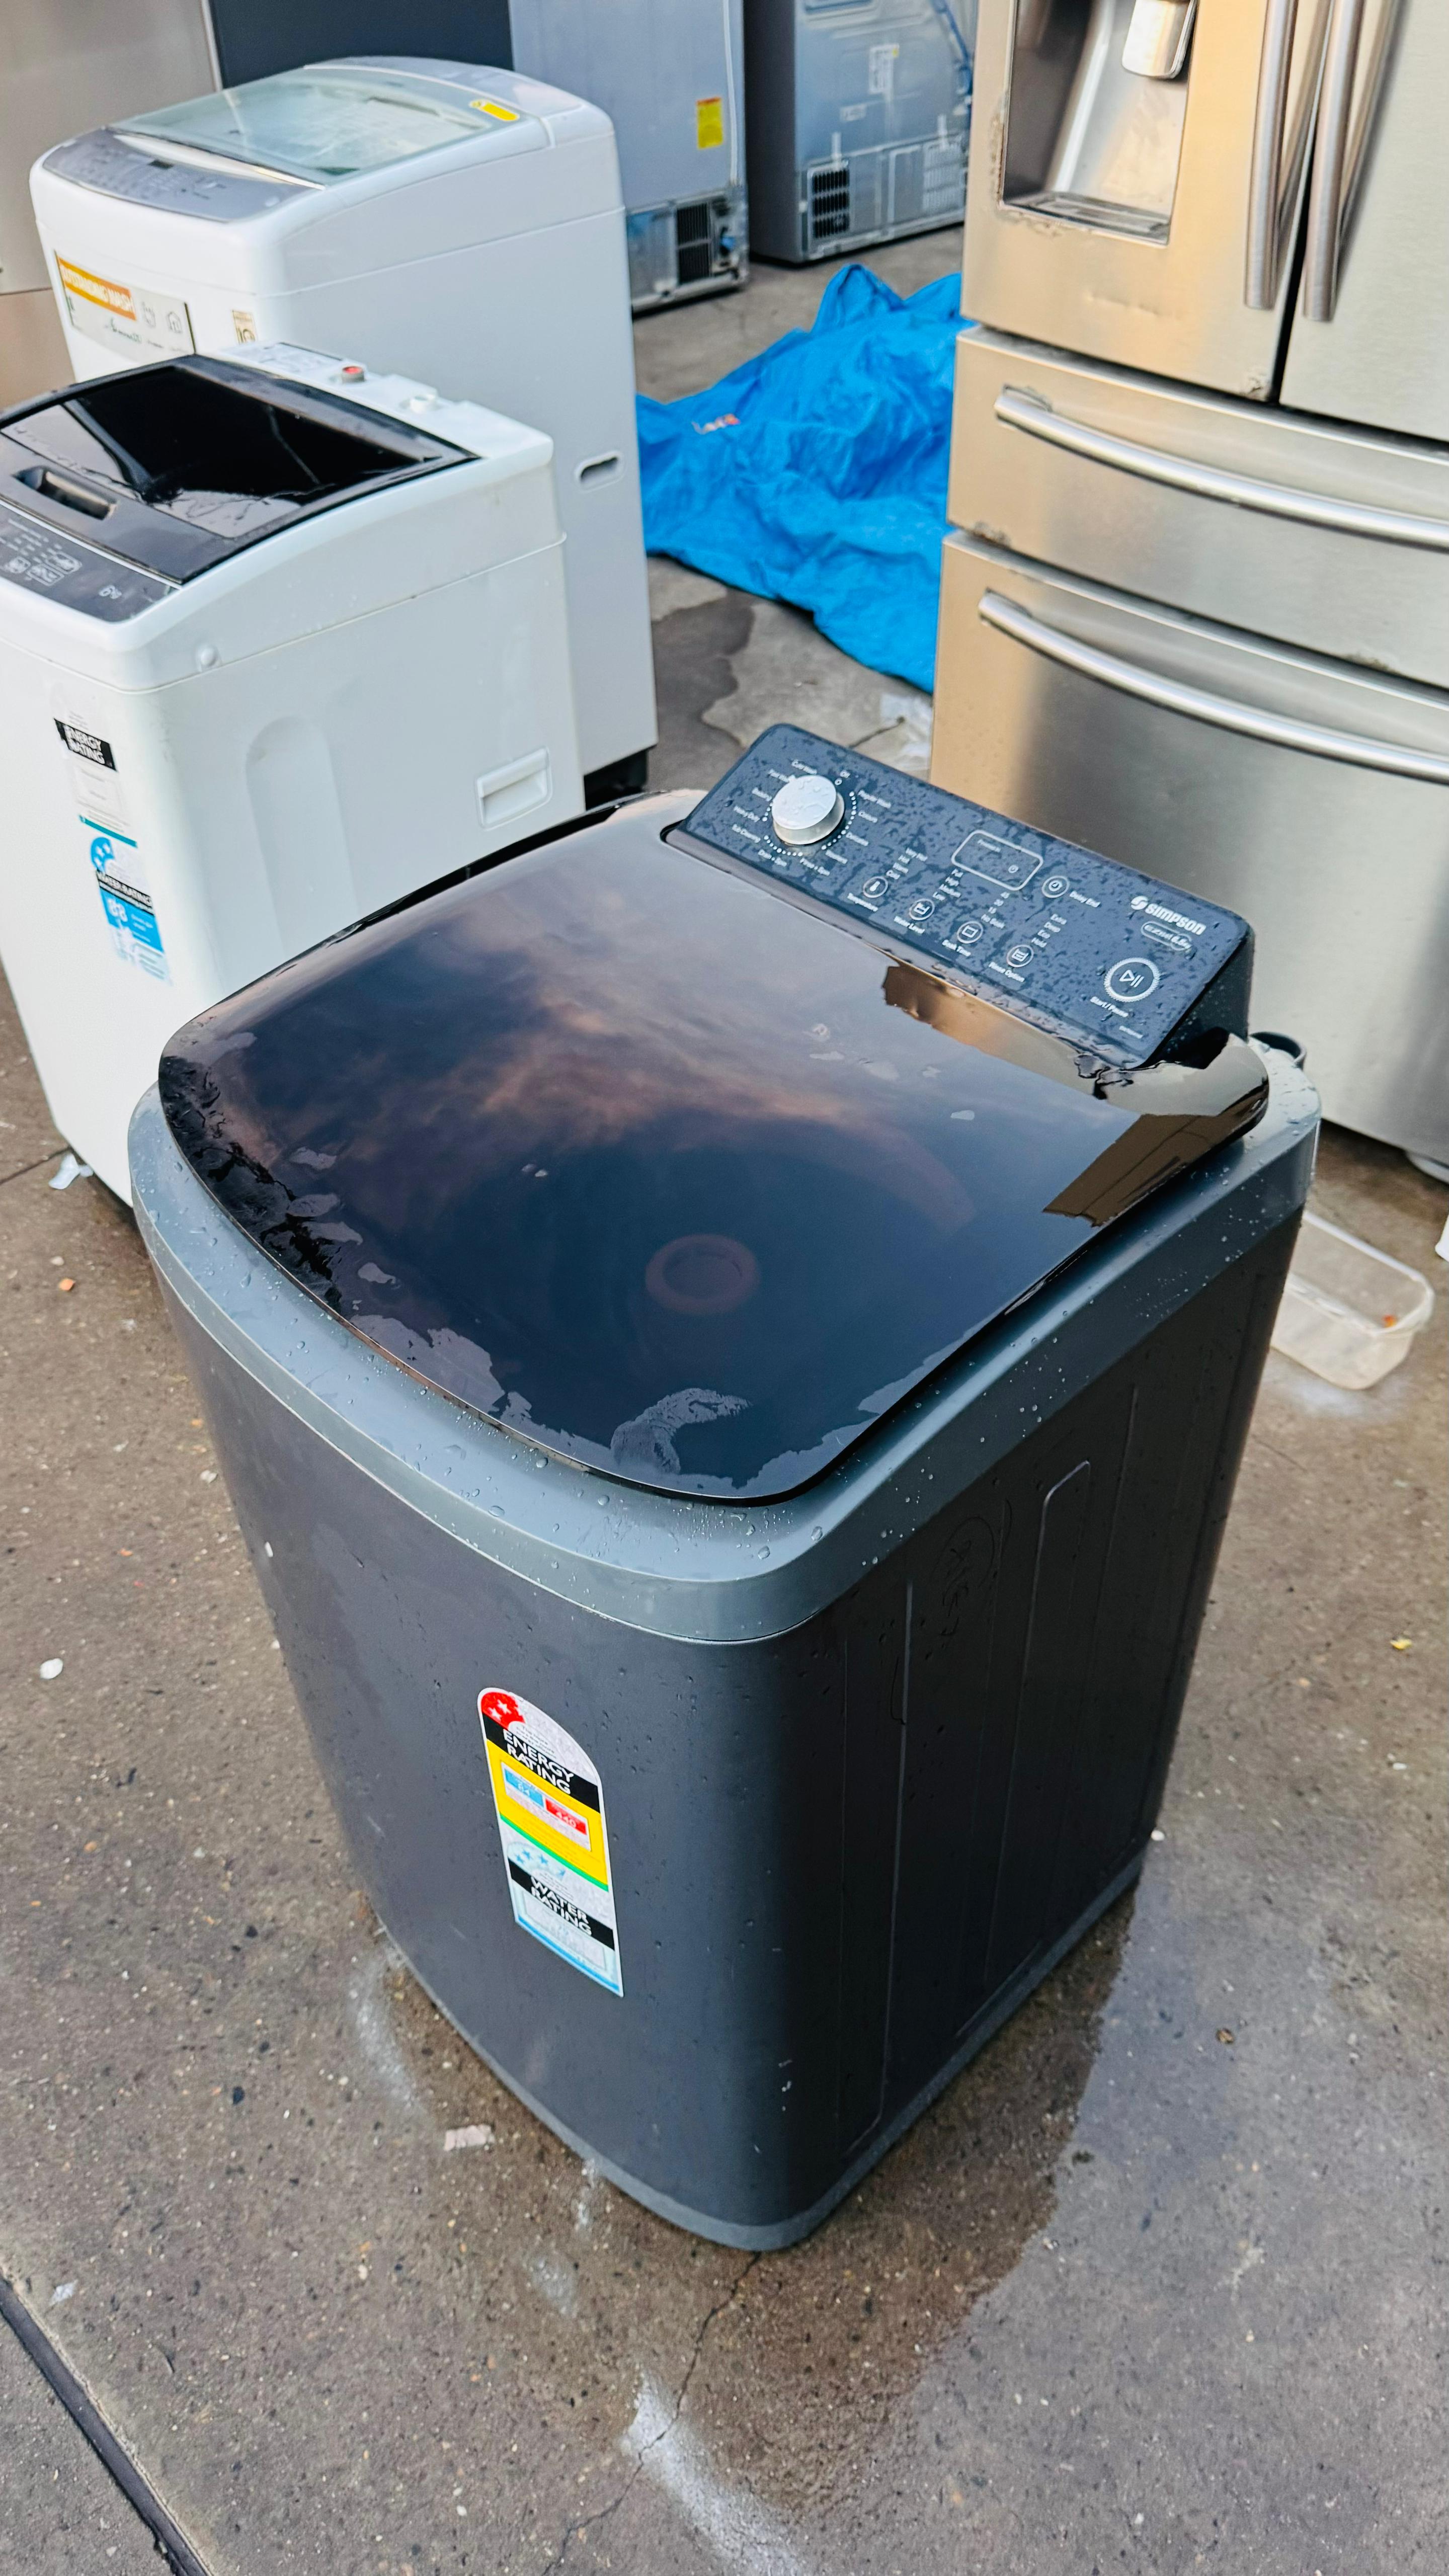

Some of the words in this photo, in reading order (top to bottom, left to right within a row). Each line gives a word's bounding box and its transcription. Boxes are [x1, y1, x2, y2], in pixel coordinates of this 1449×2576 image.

[1145, 903, 1206, 935] SIMPSON
[503, 1728, 574, 1783] ENERGY
[507, 1743, 571, 1794] RATING
[530, 1875, 589, 1924] WATER
[531, 1886, 592, 1936] RATING
